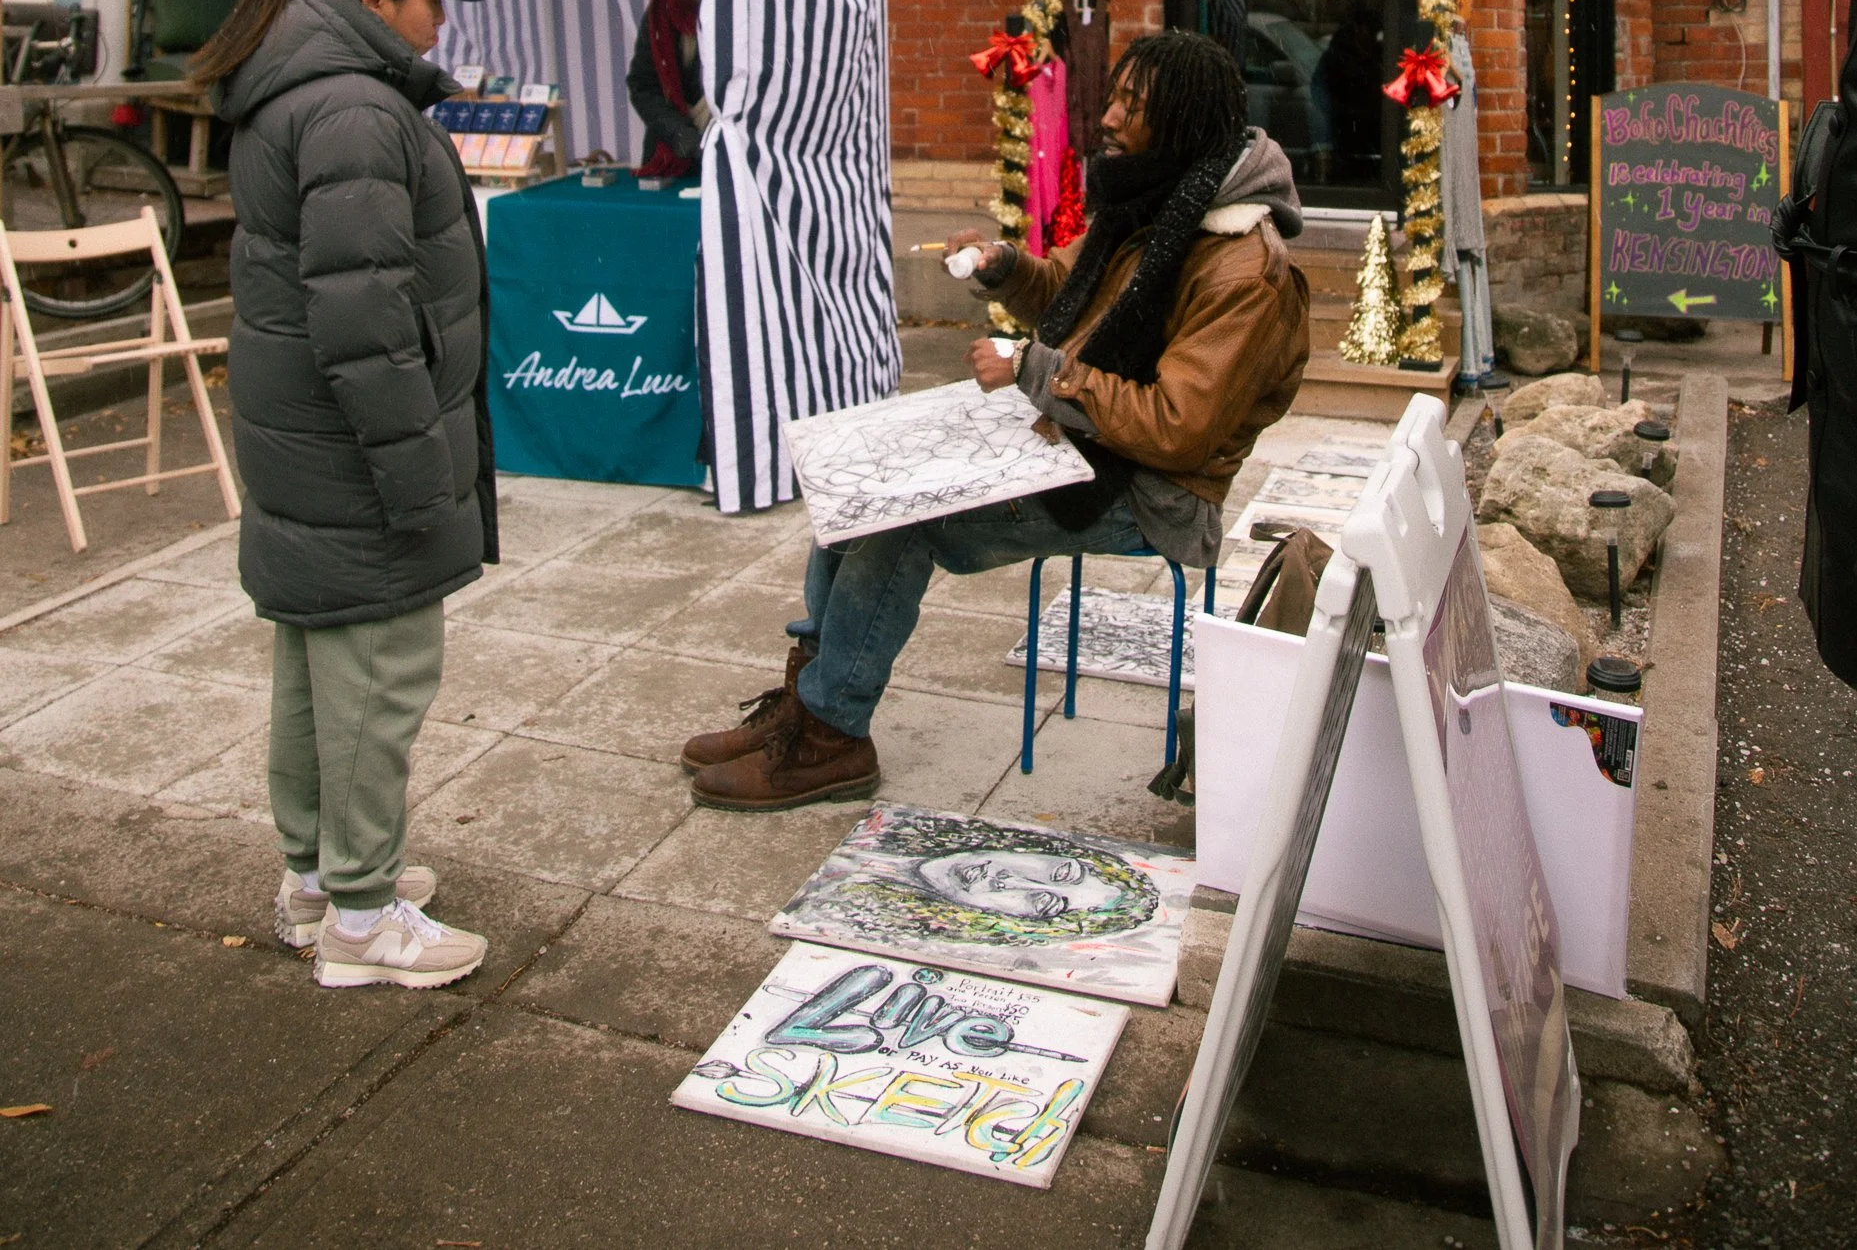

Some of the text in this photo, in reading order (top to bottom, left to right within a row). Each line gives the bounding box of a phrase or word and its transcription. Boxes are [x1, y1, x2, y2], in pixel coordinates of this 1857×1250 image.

[1632, 159, 1746, 200] celebrating
[1655, 186, 1675, 220] 1
[1747, 202, 1771, 225] in
[1609, 228, 1780, 281] KENSINGTON
[503, 351, 691, 399] Andrea Luu
[906, 1050, 938, 1066] PAY
[939, 1060, 963, 1071] AS
